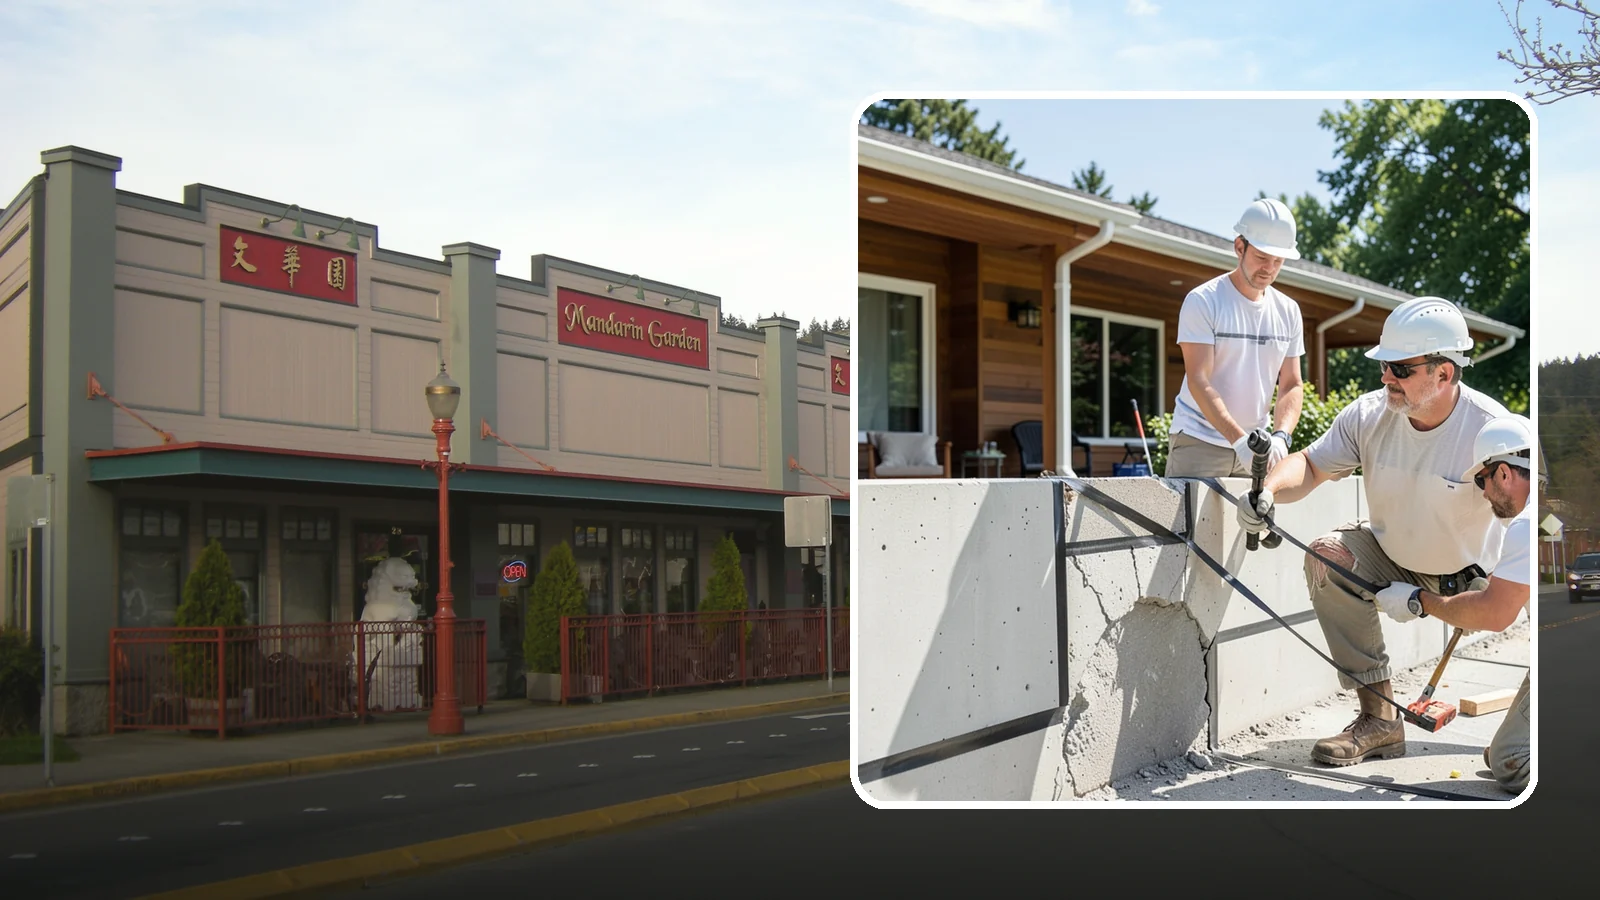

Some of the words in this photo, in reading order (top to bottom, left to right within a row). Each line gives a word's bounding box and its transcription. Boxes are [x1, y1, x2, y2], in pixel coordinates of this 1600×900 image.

[564, 302, 644, 341] Mandarin
[648, 320, 701, 352] Garden
[503, 565, 527, 578] OPEN
